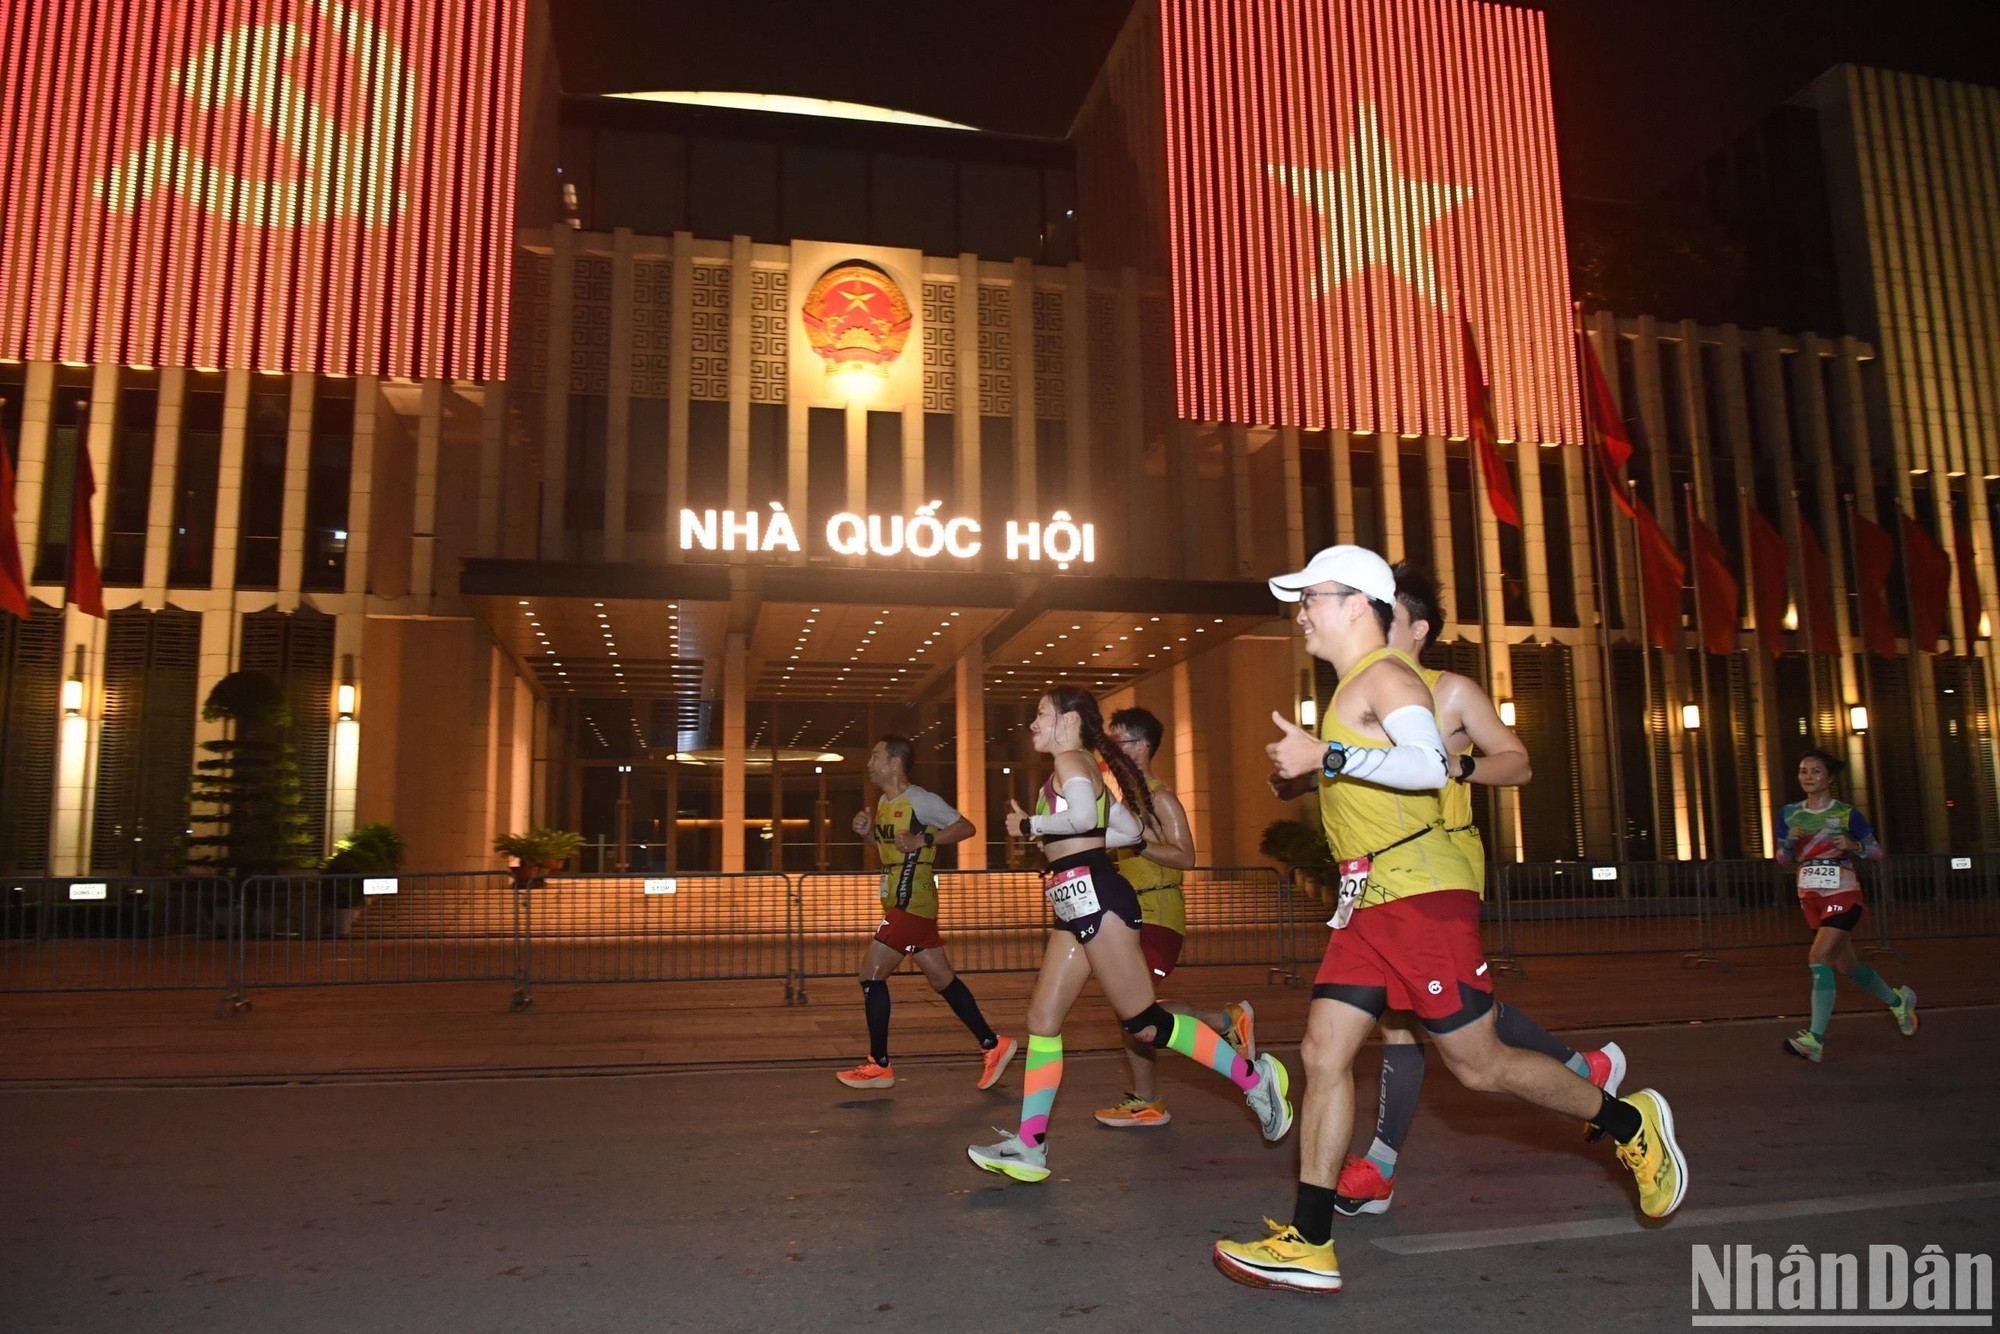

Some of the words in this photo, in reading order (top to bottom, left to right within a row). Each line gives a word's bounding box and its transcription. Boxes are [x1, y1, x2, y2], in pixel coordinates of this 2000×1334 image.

[680, 502, 800, 551] NHÀ
[826, 500, 981, 557] QUỐC
[1006, 511, 1095, 569] HỘI
[1802, 867, 1836, 877] 99428
[1050, 880, 1087, 905] 142210
